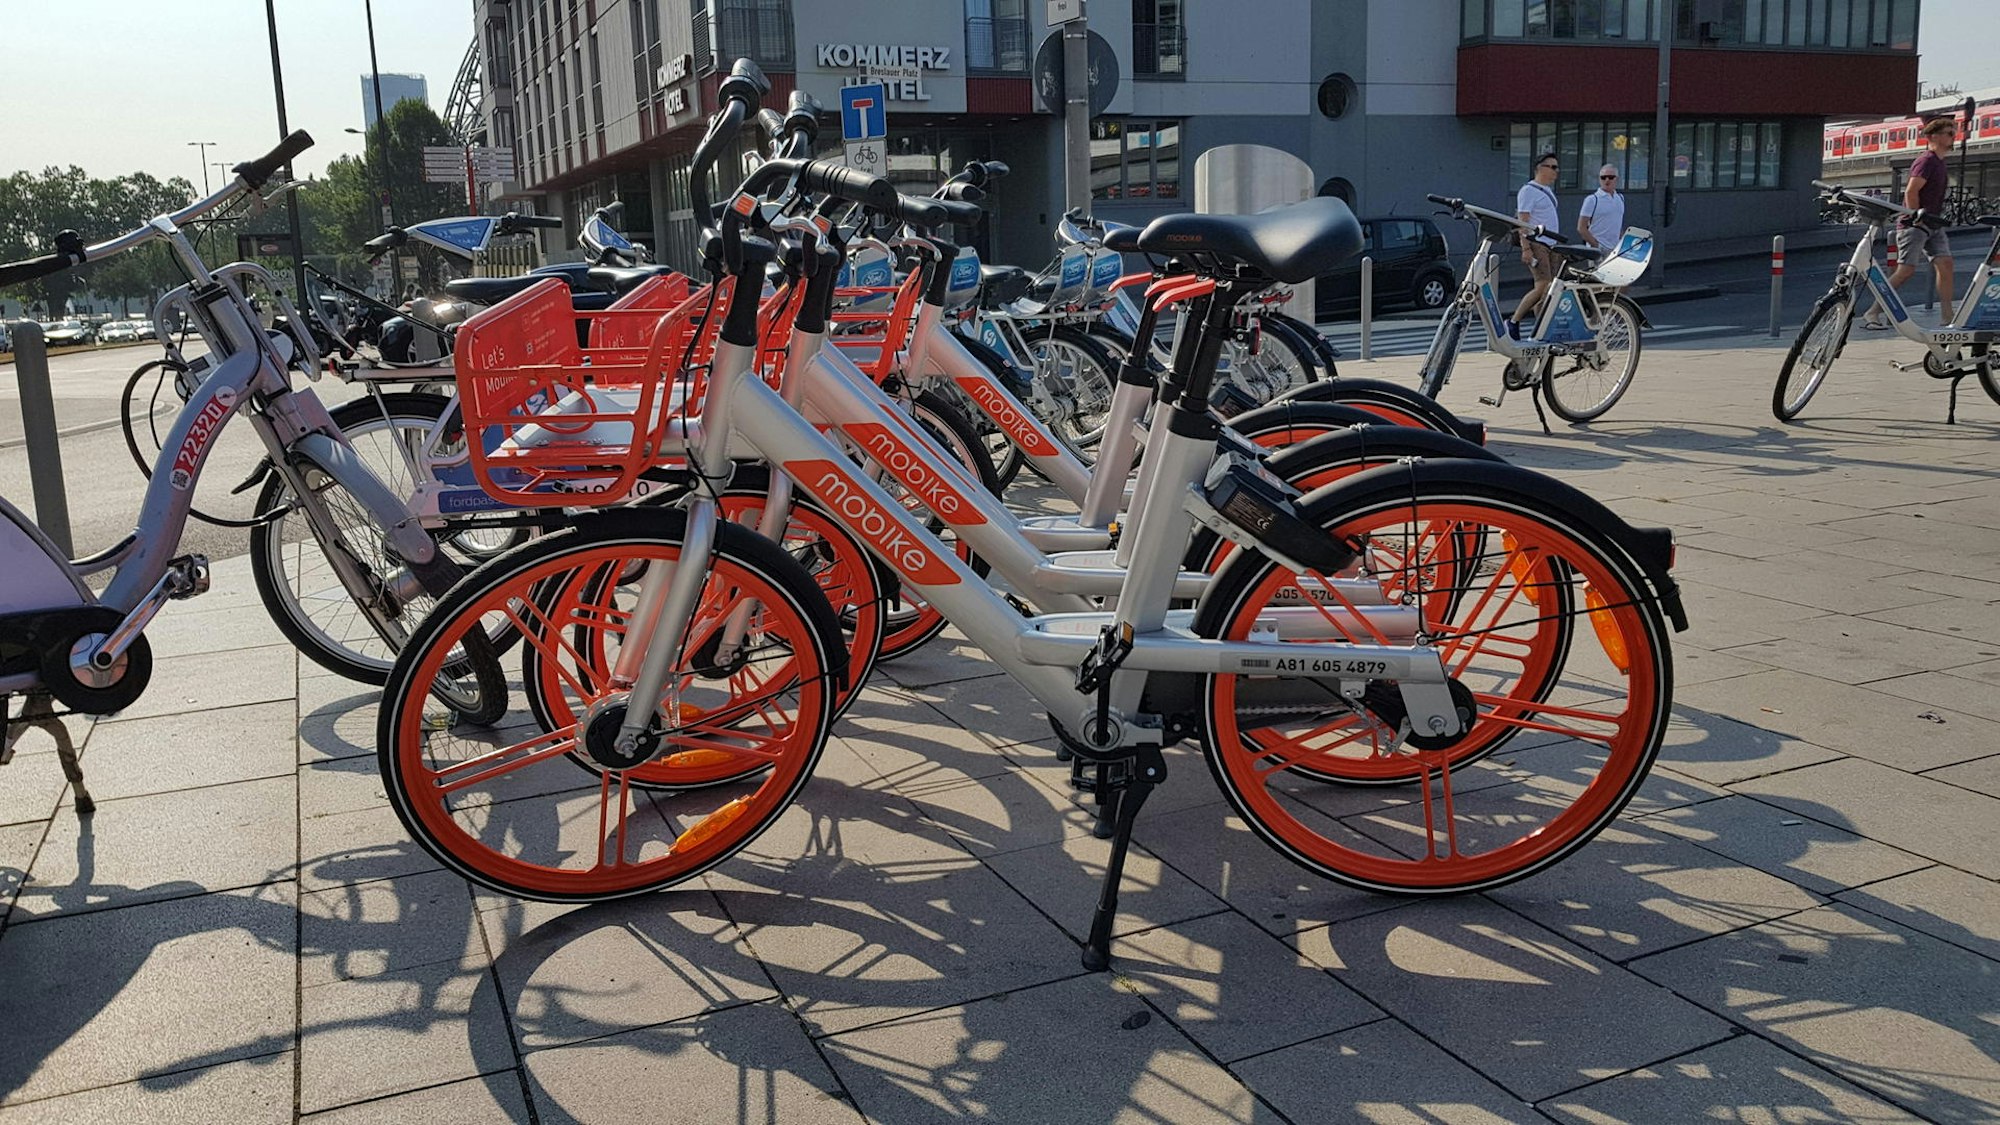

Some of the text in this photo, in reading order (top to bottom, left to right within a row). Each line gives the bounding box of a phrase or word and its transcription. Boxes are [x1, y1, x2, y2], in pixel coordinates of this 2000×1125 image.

[817, 43, 950, 69] KOMMERZ
[870, 66, 918, 78] Breslauer Platz
[843, 77, 931, 100] TEL
[1932, 332, 1969, 342] 19205
[481, 344, 505, 370] Let's
[975, 384, 1039, 448] mobike
[179, 402, 223, 467] 22320
[869, 433, 959, 515] mobike
[816, 472, 926, 572] mobike
[1275, 589, 1334, 601] 605 570
[1276, 658, 1387, 674] A81 605 4879
